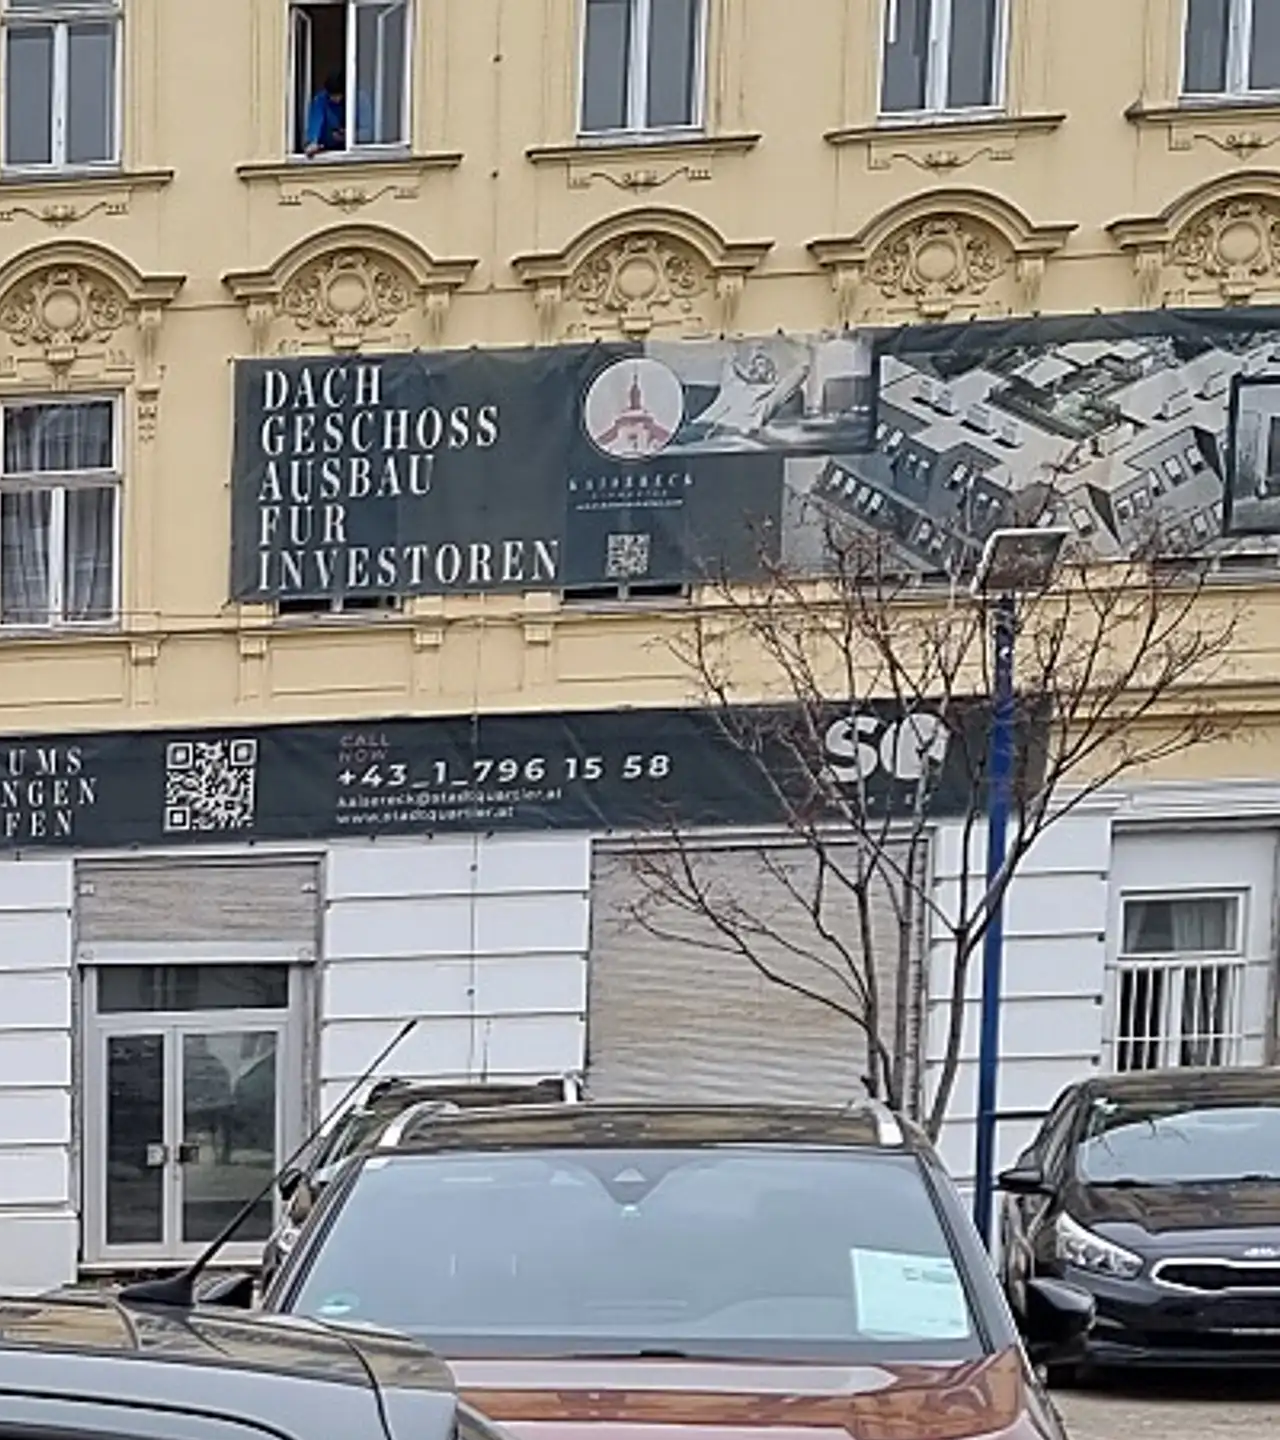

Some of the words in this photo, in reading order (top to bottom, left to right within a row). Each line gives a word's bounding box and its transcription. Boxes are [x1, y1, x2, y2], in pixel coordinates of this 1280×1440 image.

[262, 364, 382, 411] DACH
[262, 405, 499, 456] GESCHOSS
[258, 454, 436, 502] AUSBAU
[258, 539, 559, 591] INVESTOREN
[338, 749, 389, 763] NOW
[339, 733, 390, 748] CALL
[564, 756, 603, 780] 15
[621, 754, 671, 779] 58
